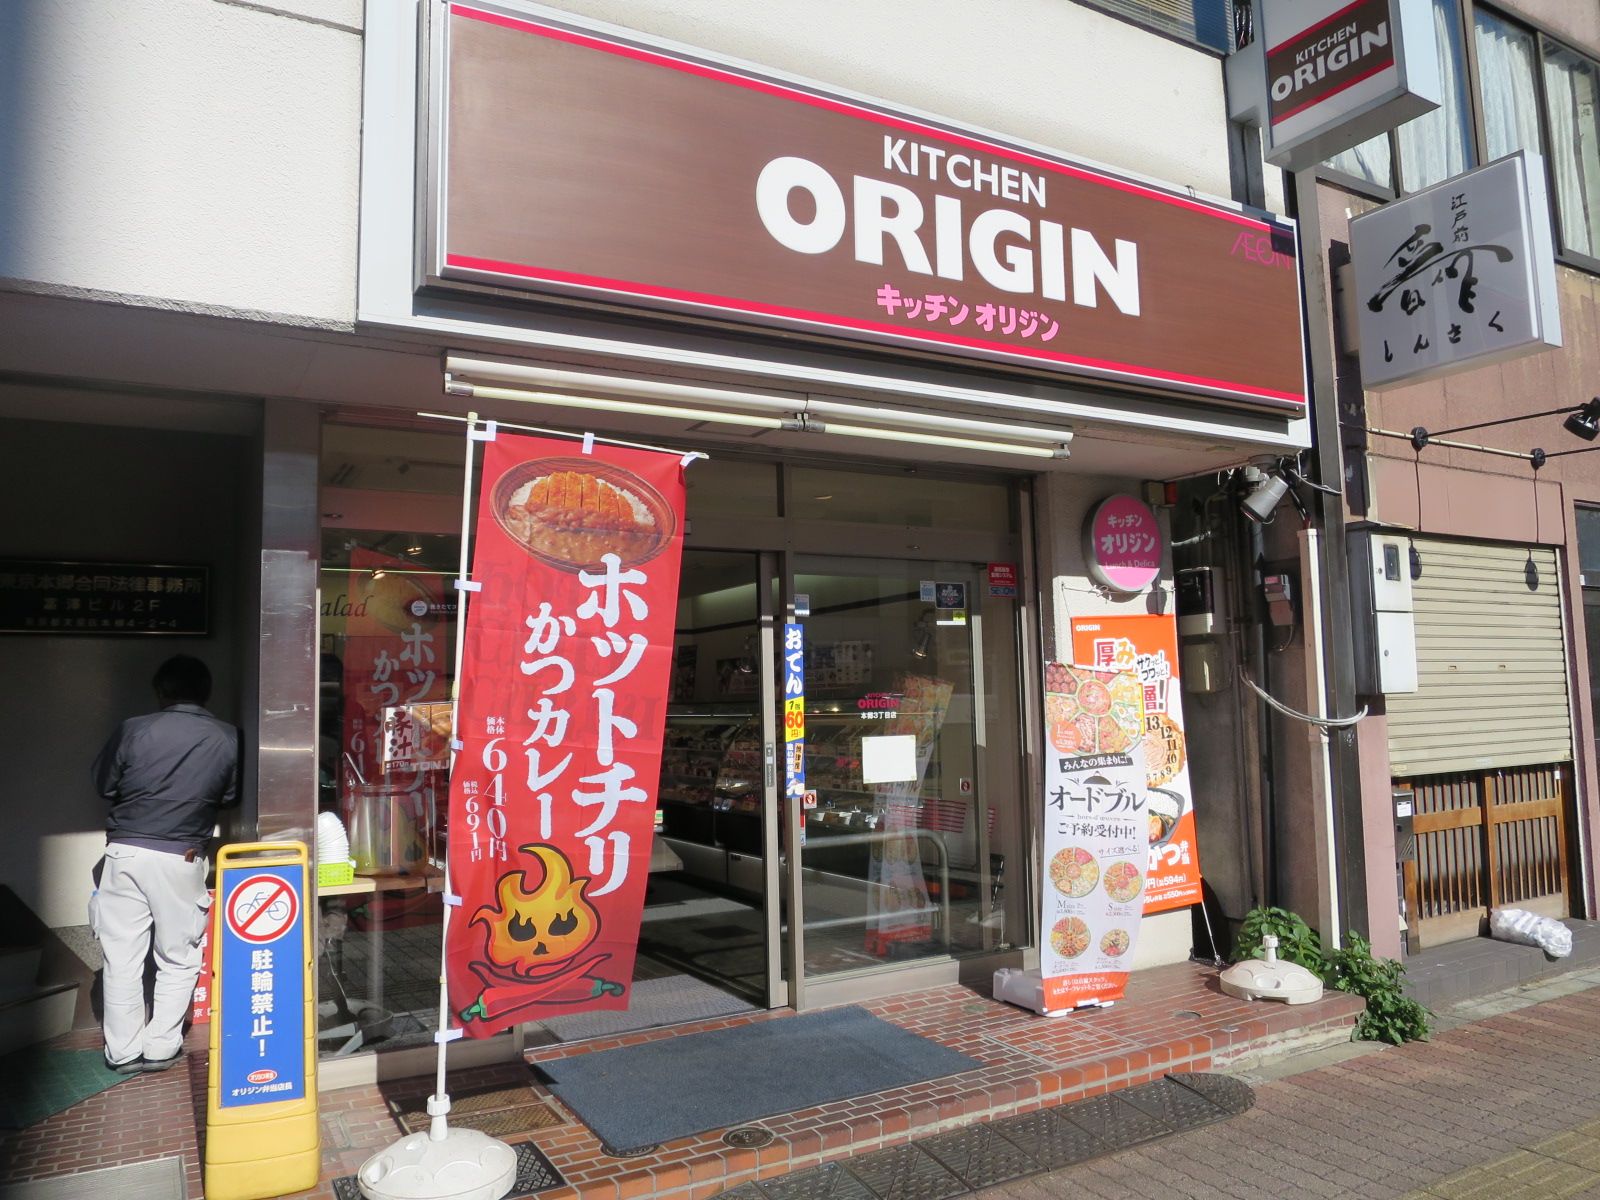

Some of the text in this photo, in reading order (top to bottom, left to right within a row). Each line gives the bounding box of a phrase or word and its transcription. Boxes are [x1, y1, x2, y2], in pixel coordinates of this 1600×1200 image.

[1271, 21, 1389, 101] ORIGIN
[1295, 22, 1357, 64] KITCHEN
[883, 135, 1047, 208] KITCHEN
[756, 156, 1140, 316] ORIGIN
[876, 284, 1059, 342] キッチン オリジン
[1384, 311, 1504, 362] しんさく
[1101, 533, 1156, 554] オリジン
[1107, 514, 1142, 528] キッチン
[785, 628, 803, 695] おでん
[520, 602, 577, 840] かつカレー
[572, 553, 648, 896] ホットチリ
[786, 711, 804, 729] 60
[857, 698, 899, 709] ORIGIN
[1146, 715, 1160, 732] 13
[1161, 725, 1173, 739] 12
[1048, 785, 1147, 814] オードブル
[1058, 822, 1136, 840] ご予約受付中!
[251, 949, 274, 1057] 駐輪禁止!
